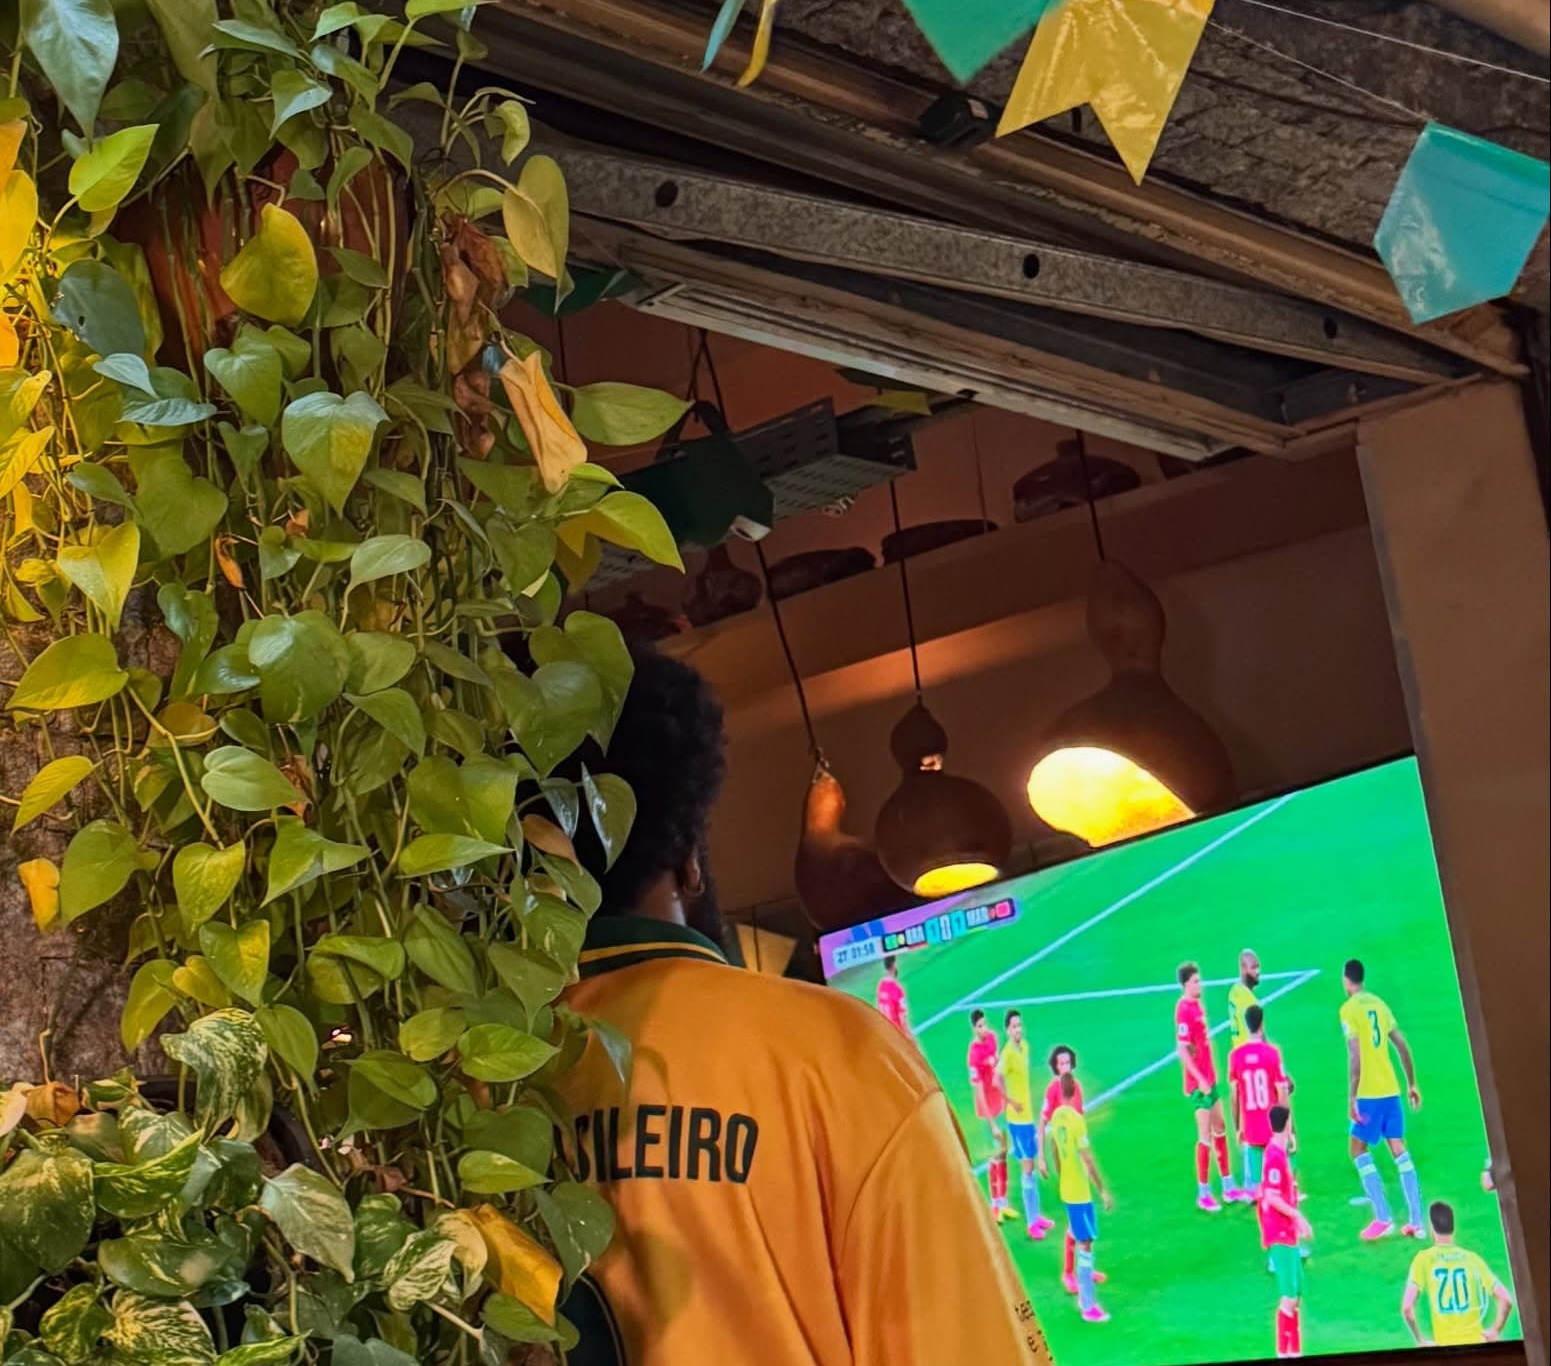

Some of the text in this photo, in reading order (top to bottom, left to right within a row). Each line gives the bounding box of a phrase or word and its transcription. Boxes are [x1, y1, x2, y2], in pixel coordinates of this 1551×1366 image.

[1368, 1010, 1381, 1048] 3
[1242, 1068, 1270, 1110] 18
[548, 1104, 759, 1184] SILEIRO
[1433, 1267, 1470, 1314] 20
